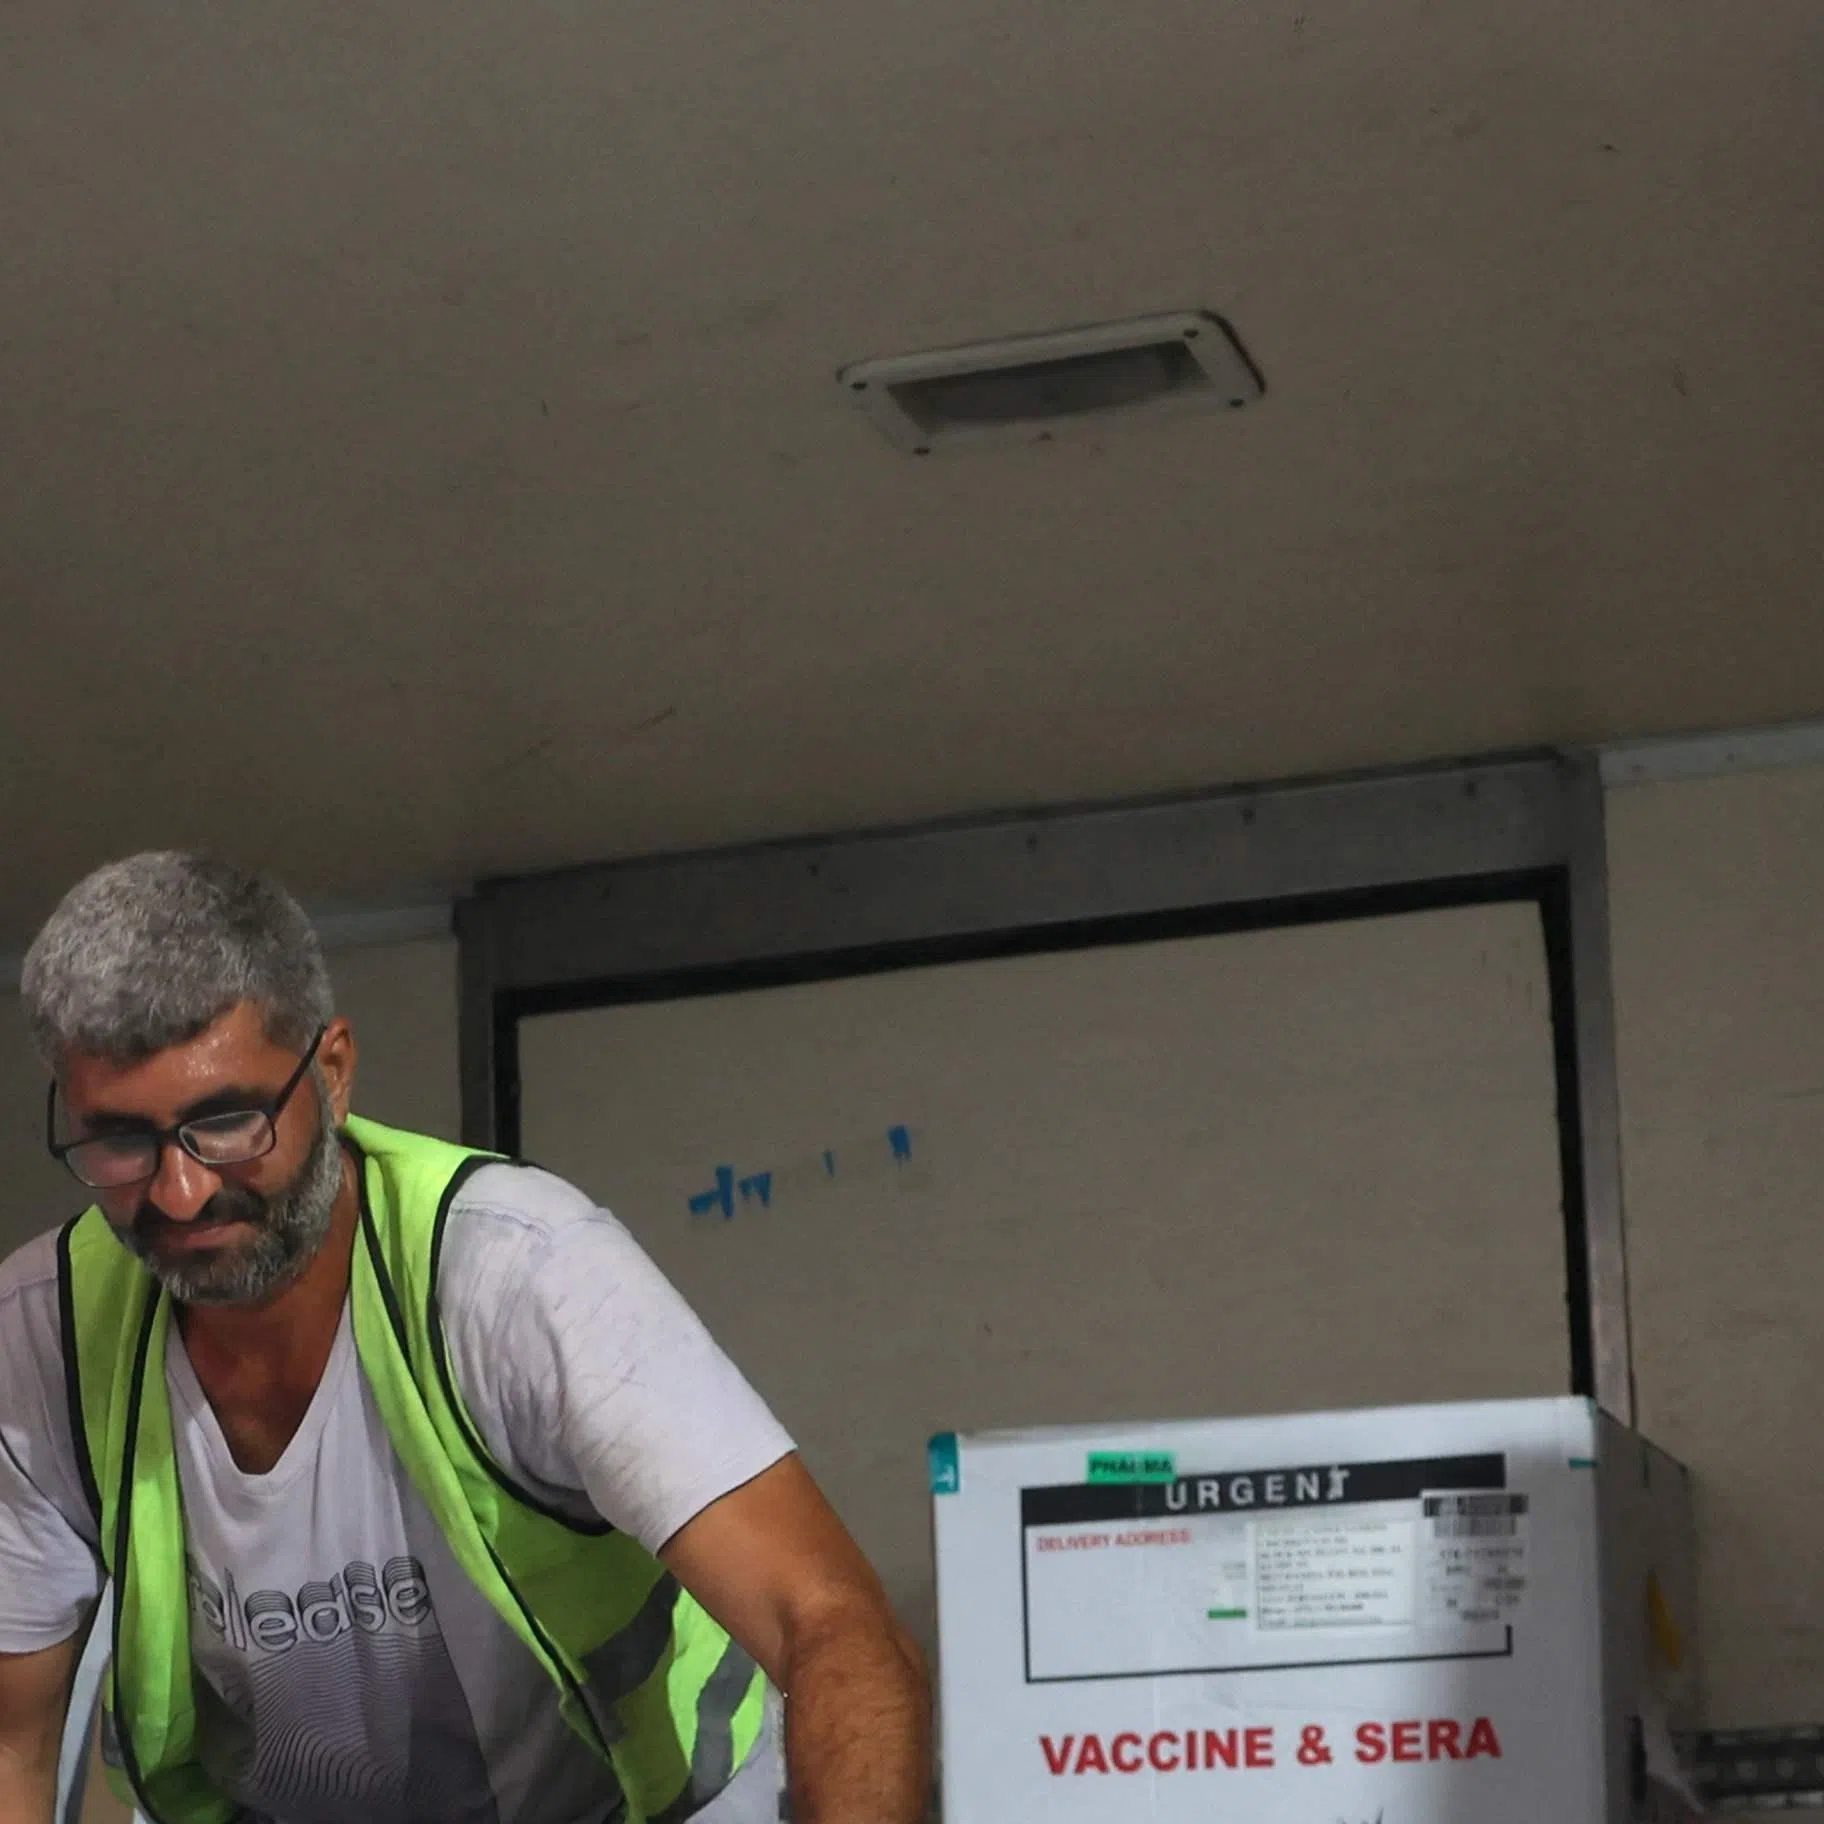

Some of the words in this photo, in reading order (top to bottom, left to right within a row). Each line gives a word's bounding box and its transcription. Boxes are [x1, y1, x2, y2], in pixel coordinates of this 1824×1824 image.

[1165, 1466, 1350, 1511] URGENT
[1039, 1726, 1274, 1777] VACCINE
[1295, 1720, 1334, 1767] &
[1354, 1715, 1503, 1766] SERA
